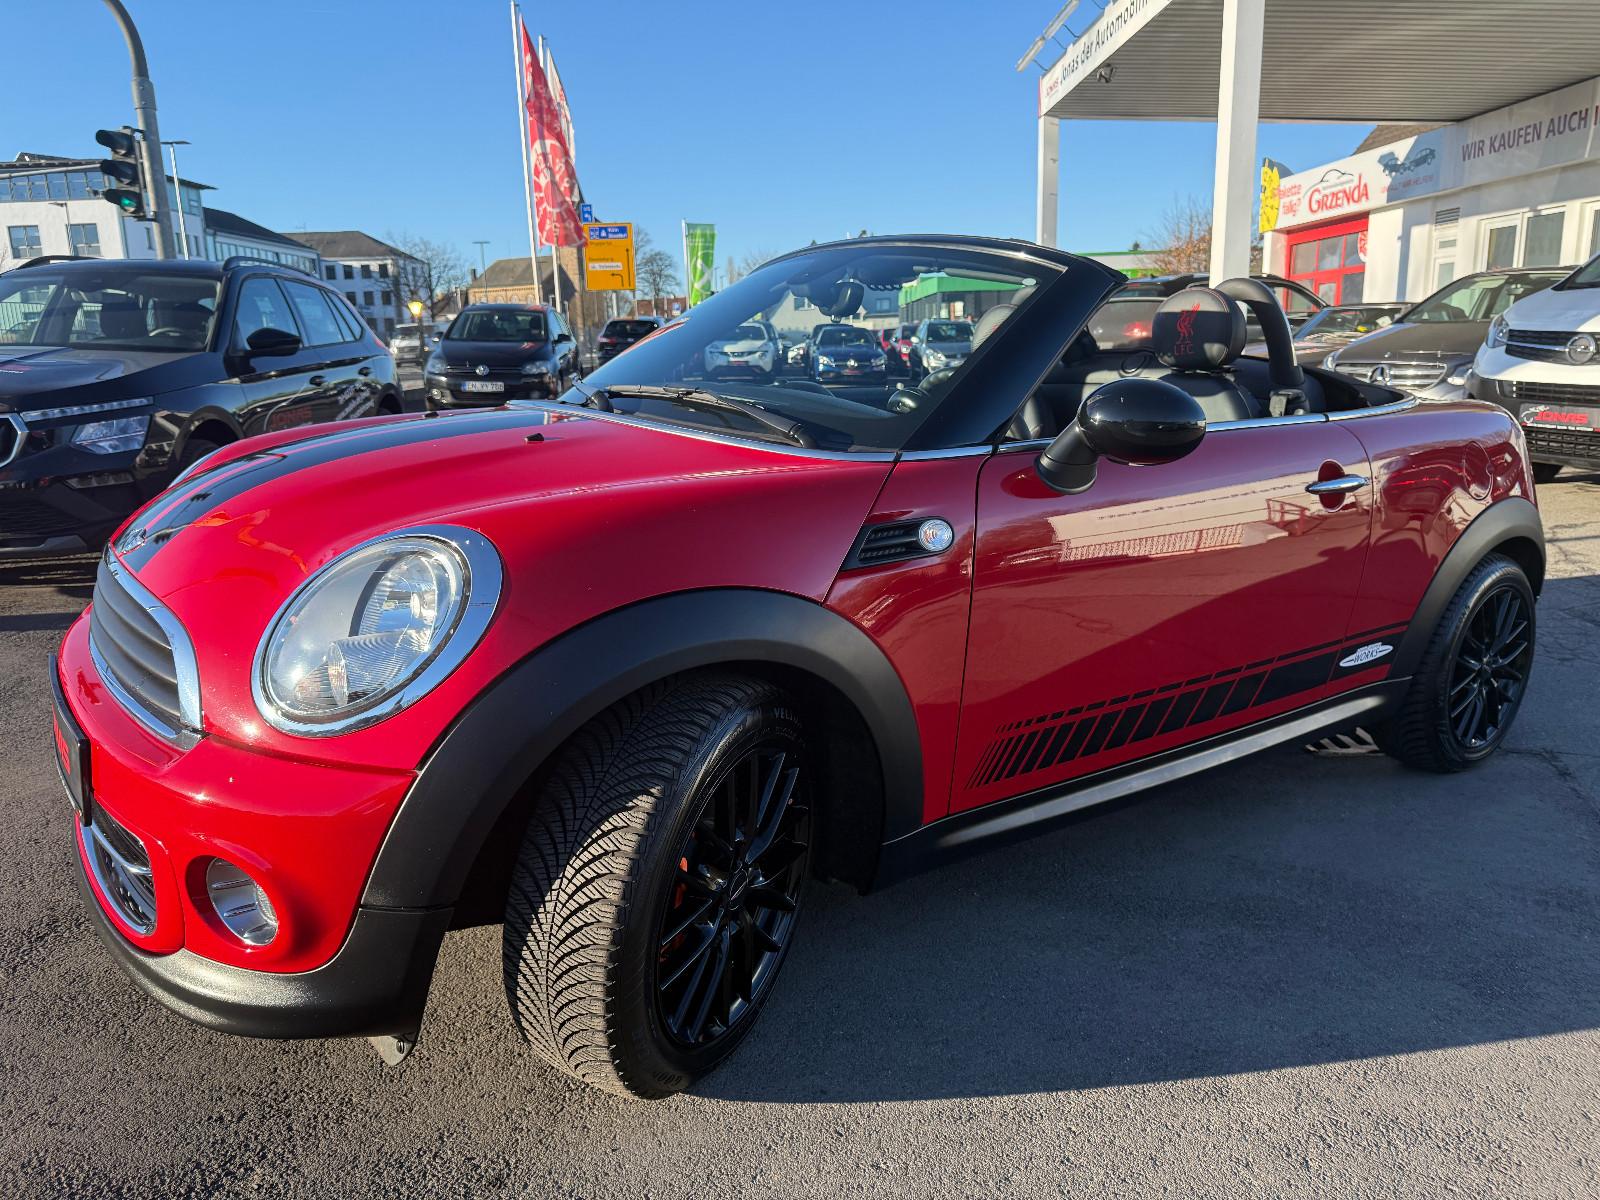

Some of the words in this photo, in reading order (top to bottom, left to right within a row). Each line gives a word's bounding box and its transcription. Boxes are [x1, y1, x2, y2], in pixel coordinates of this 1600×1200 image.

[1461, 139, 1485, 162] WIR
[1489, 121, 1542, 154] KAUFEN
[1545, 108, 1589, 138] AUCH
[1534, 410, 1588, 425] JONAS
[1353, 649, 1378, 663] WORKS
